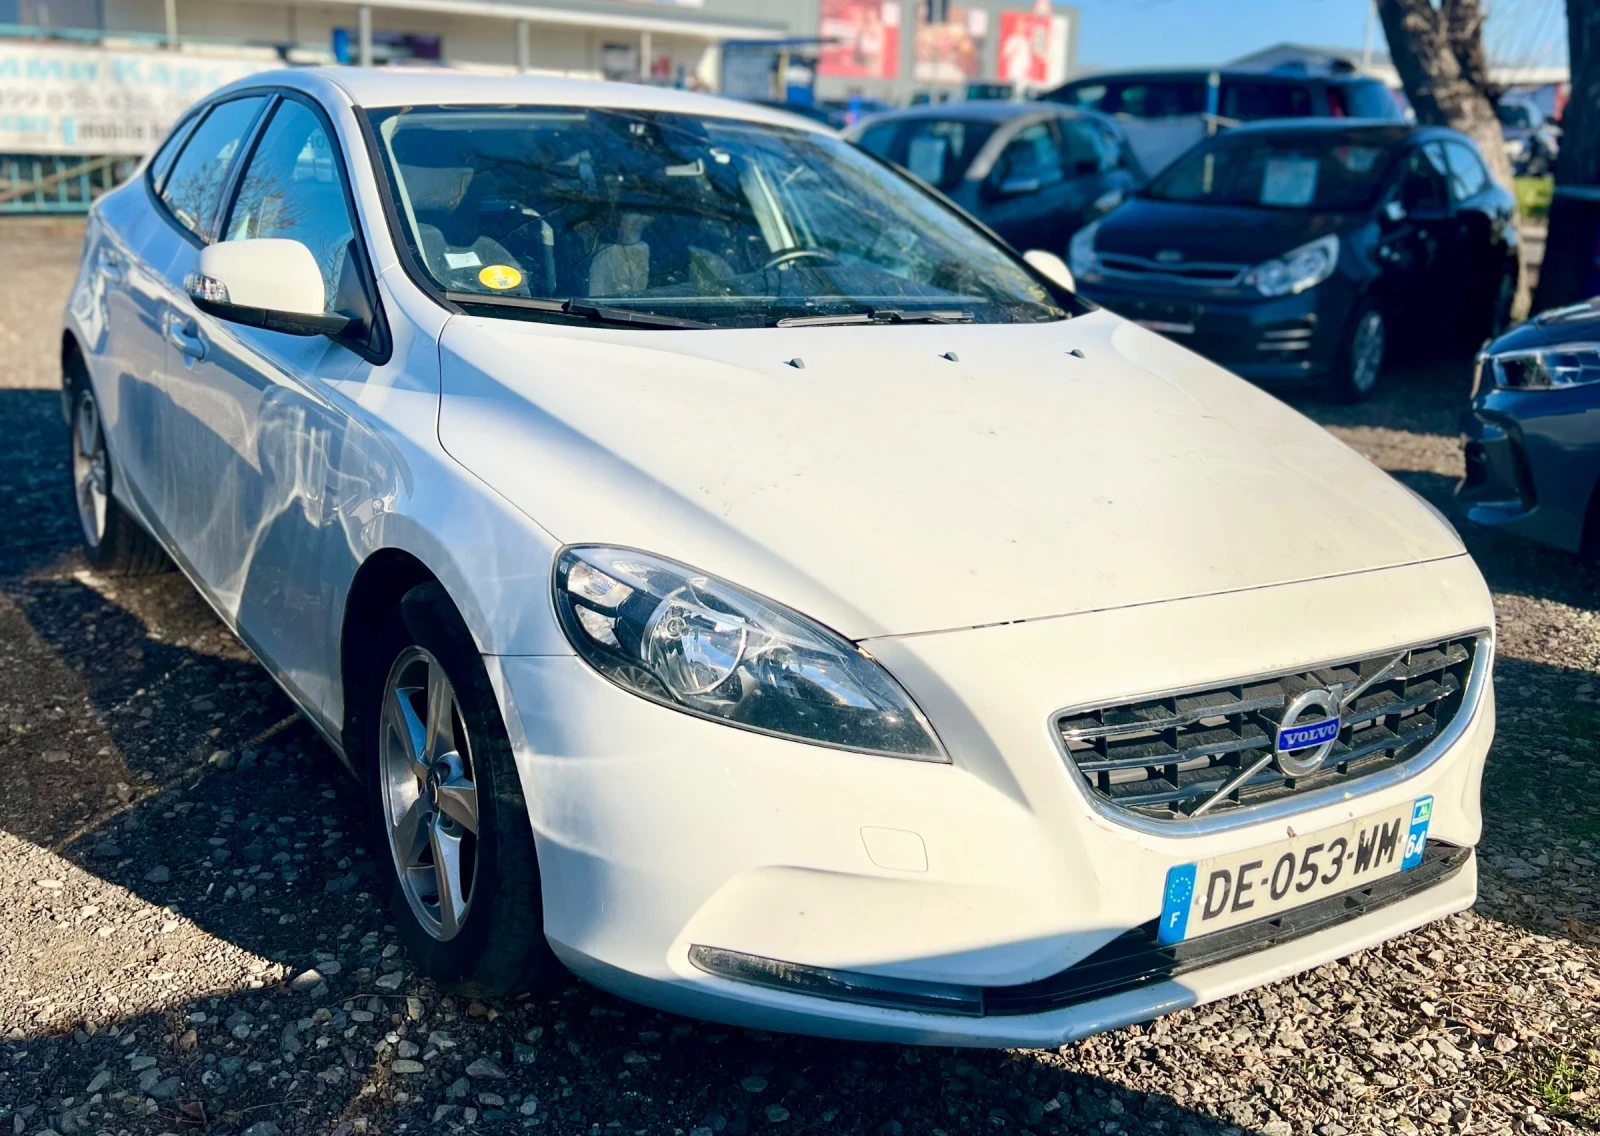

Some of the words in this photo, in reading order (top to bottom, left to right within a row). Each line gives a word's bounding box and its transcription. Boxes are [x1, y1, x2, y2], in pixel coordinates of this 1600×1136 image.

[1284, 724, 1337, 745] VOLVO
[1170, 912, 1180, 929] F
[1202, 818, 1401, 920] DE-053-WM
[1405, 831, 1426, 858] 64
